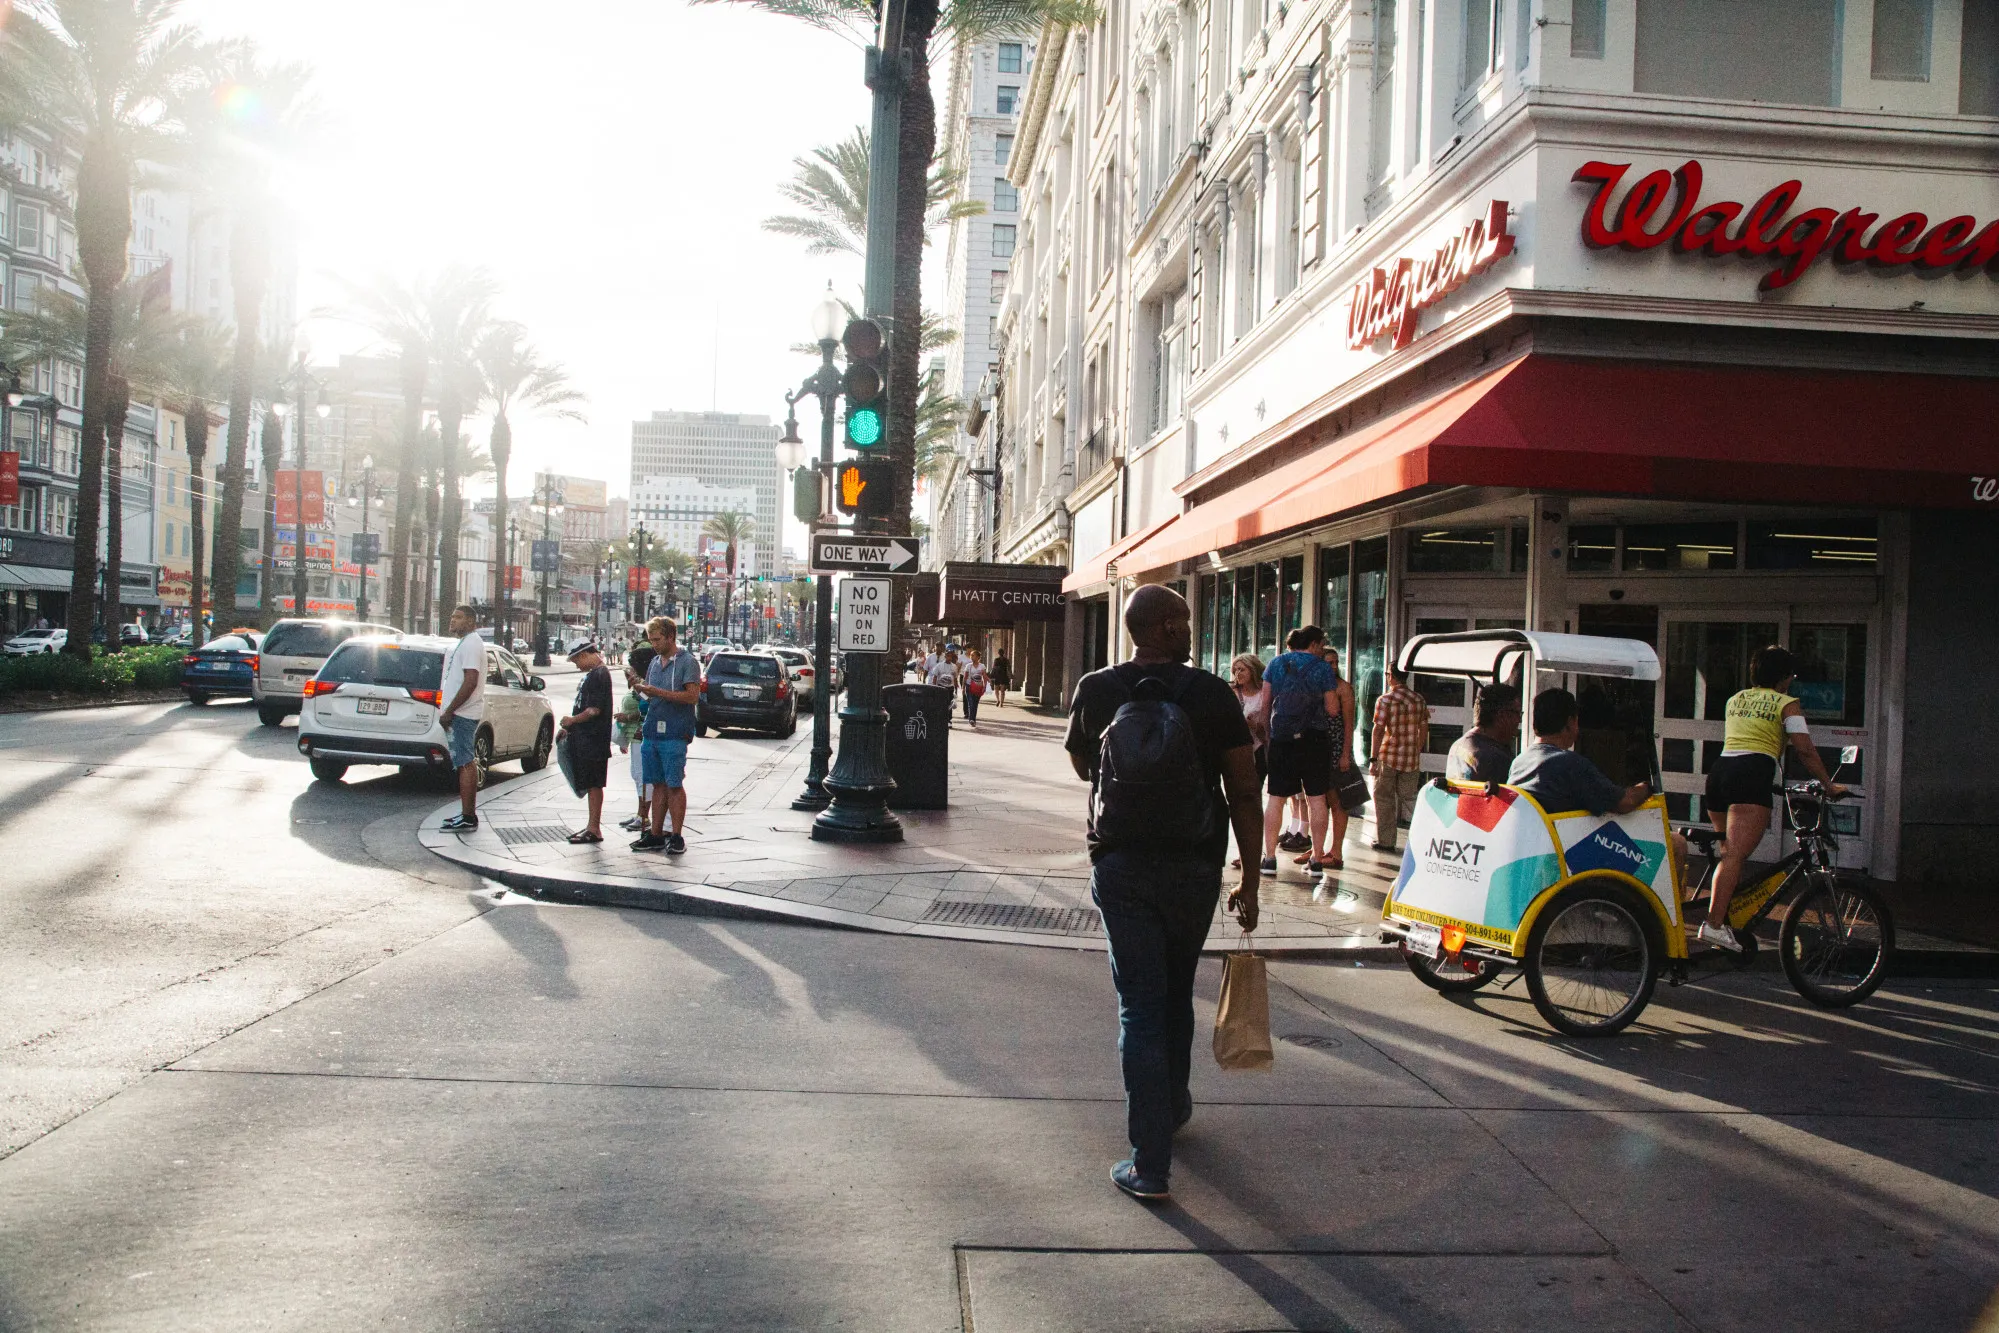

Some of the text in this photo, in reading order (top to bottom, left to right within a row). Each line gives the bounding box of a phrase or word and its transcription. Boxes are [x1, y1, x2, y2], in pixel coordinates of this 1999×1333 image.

[1345, 199, 1514, 351] Walgreens
[824, 545, 888, 562] ONE WAY
[852, 586, 878, 601] NO
[952, 589, 1066, 606] HYATT CENTRIC
[283, 599, 355, 612] Wlgreens
[849, 604, 880, 615] TURN
[855, 619, 873, 630] ON
[852, 634, 876, 645] RED
[1425, 837, 1486, 866] .NEXT
[1594, 833, 1652, 868] NUTANIX
[1426, 861, 1481, 883] CONFERENCE
[1415, 909, 1448, 929] UNLIMITED
[1464, 923, 1512, 945] 504-891-3441
